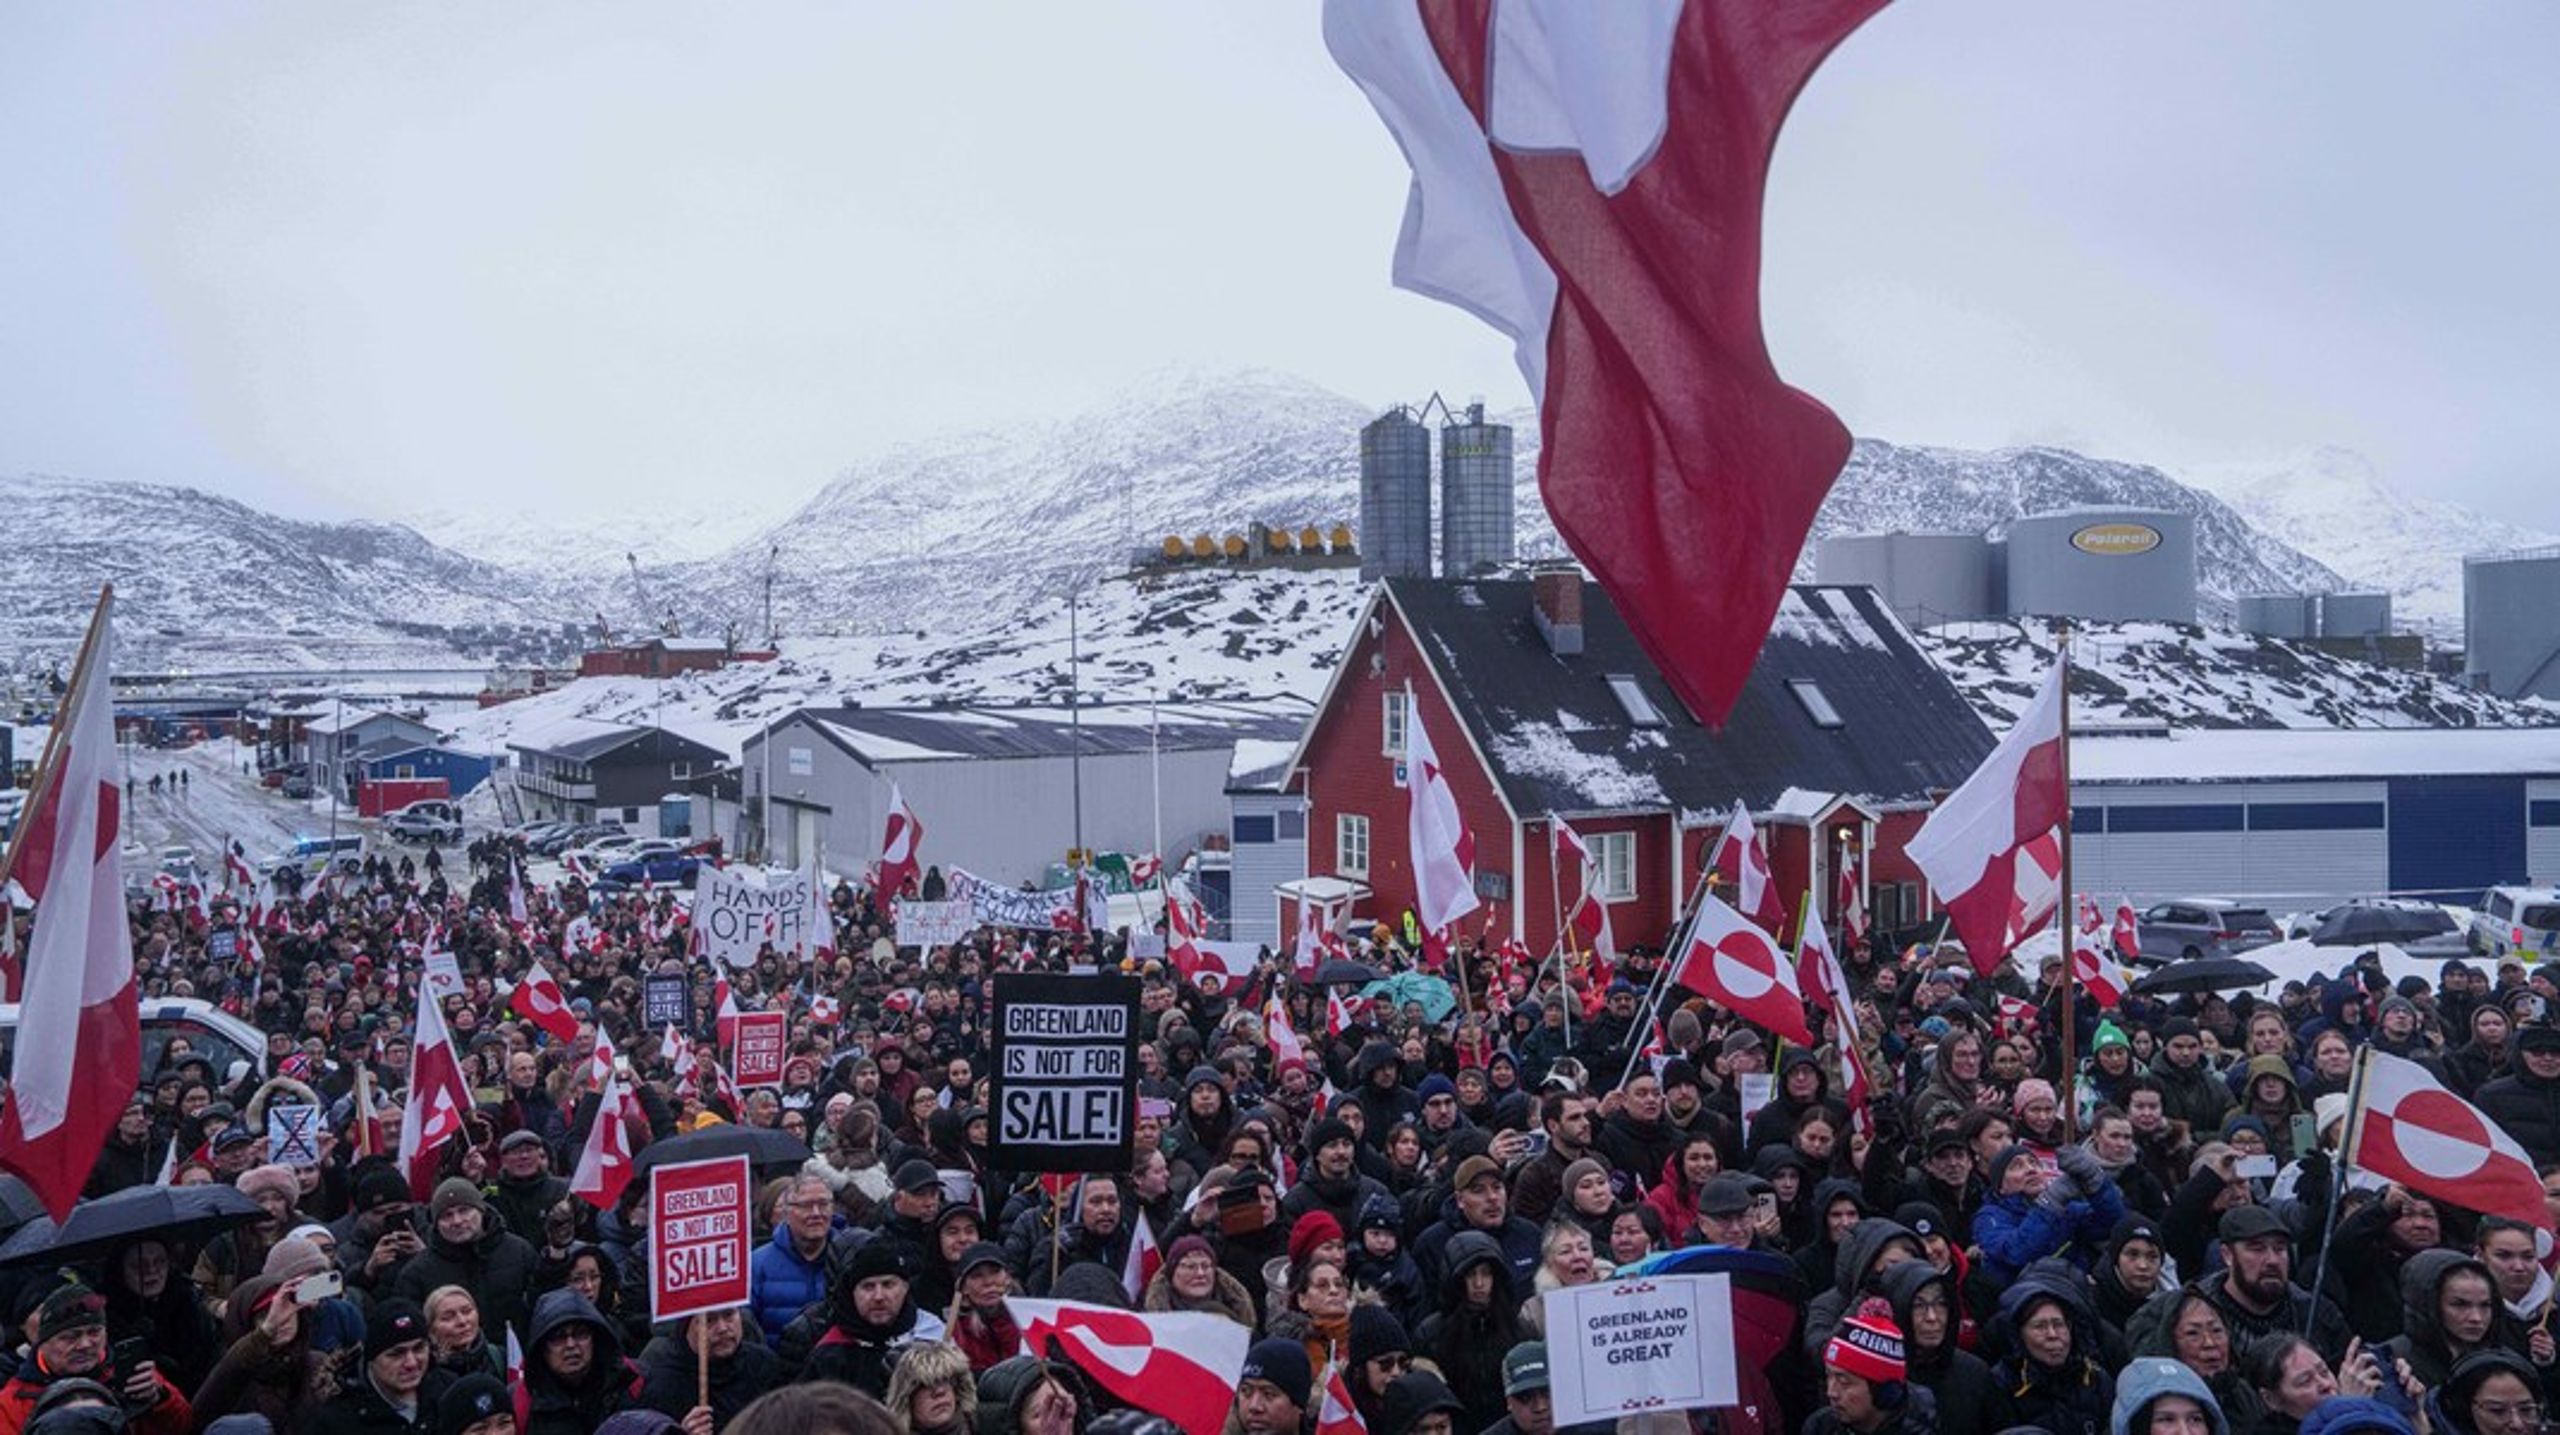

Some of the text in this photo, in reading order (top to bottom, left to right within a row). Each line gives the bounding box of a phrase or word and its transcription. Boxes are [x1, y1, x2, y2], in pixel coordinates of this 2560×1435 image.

[712, 881, 807, 908] HANDS
[1008, 1006, 1124, 1035] GREENLAND
[1007, 1050, 1121, 1074] IS NOT FOR
[1005, 1091, 1119, 1141] SALE!
[667, 1186, 735, 1212] GREENLAND
[667, 1215, 735, 1239] IS NOT FOR
[669, 1241, 736, 1287] SALE!
[1588, 1307, 1688, 1330] GREENLAND
[1592, 1324, 1687, 1347] IS ALREADY
[1606, 1343, 1673, 1365] GREAT
